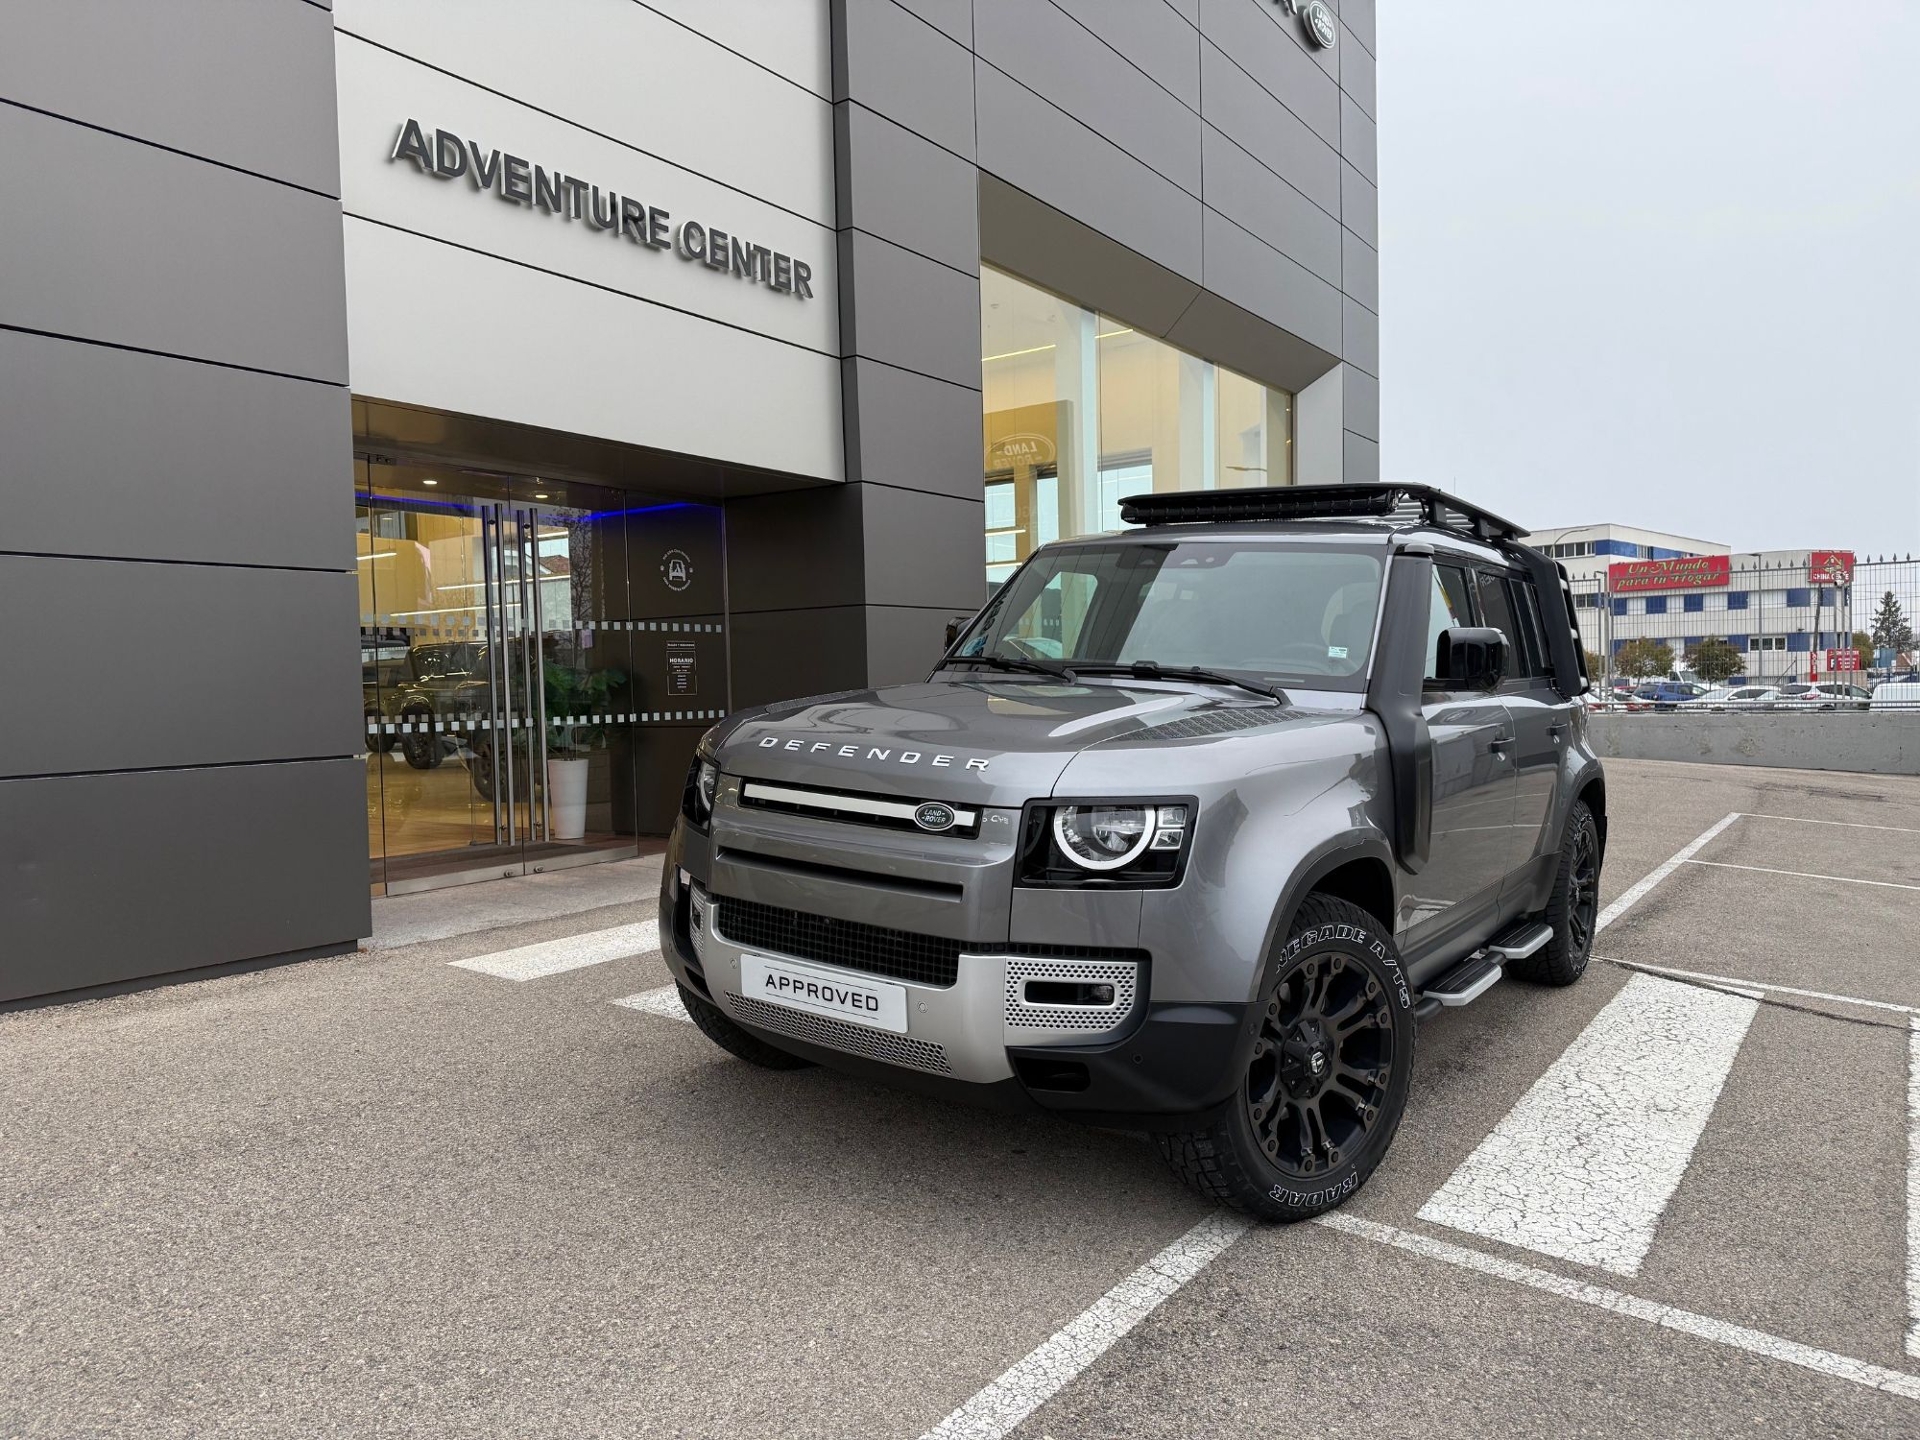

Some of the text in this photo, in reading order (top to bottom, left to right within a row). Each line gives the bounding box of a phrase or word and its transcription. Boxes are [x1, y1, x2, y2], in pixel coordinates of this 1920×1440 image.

[393, 118, 814, 299] ADVENTURE CENTER
[1617, 571, 1720, 590] para tu Hogar
[1628, 559, 1709, 574] Un Mundo
[758, 736, 990, 772] DEFENDER
[765, 974, 879, 1012] APPROVED
[1268, 1171, 1358, 1207] RADAR
